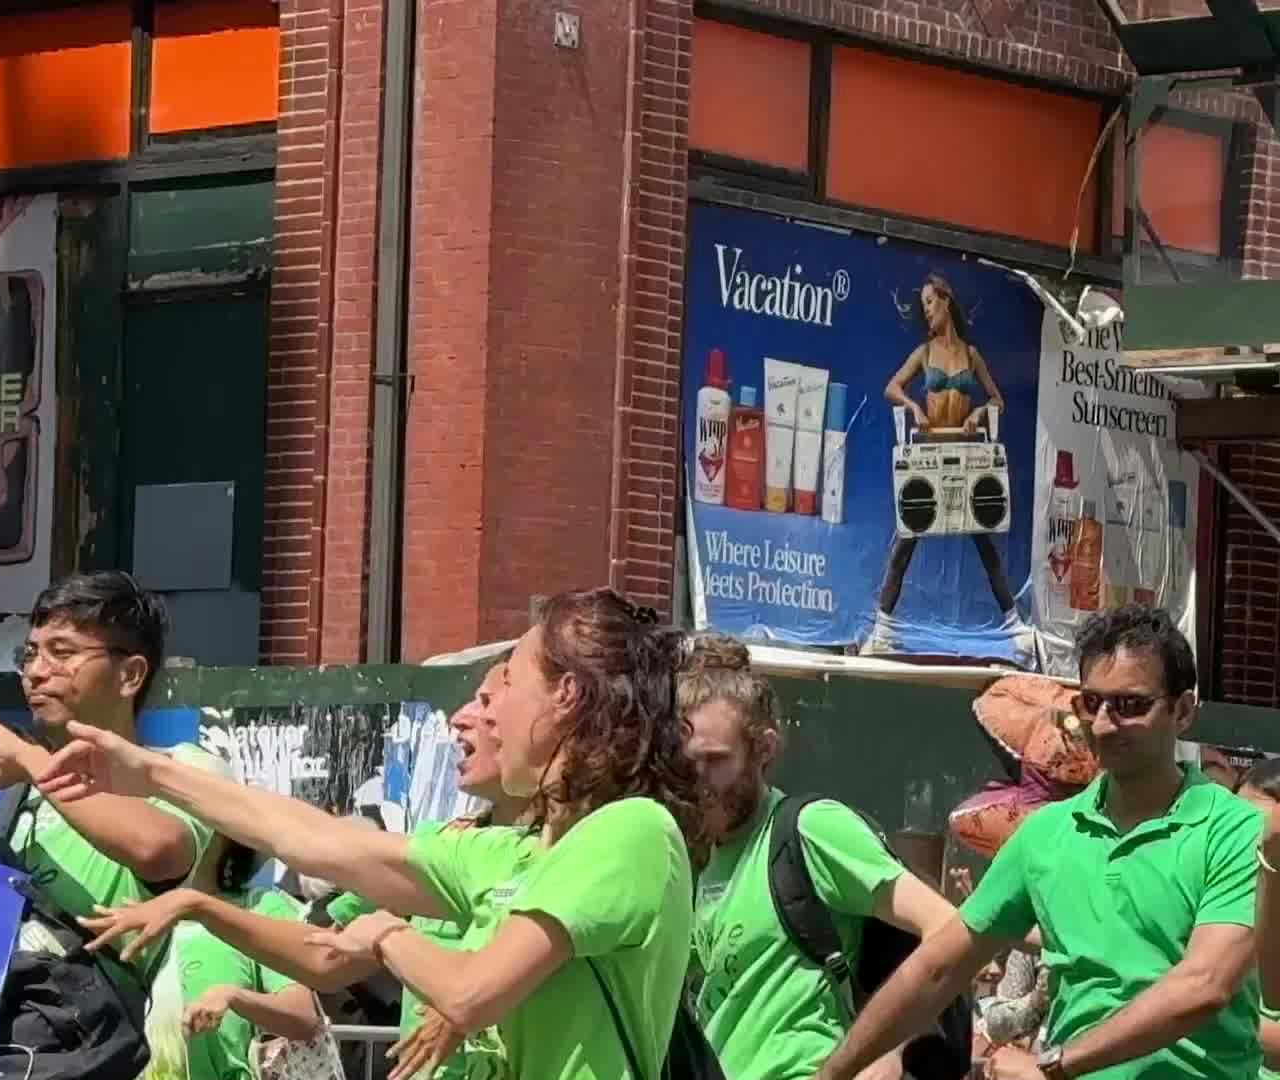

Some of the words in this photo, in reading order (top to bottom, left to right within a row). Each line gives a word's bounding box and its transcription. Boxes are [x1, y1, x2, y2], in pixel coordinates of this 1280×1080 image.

[1072, 390, 1168, 438] Sunscreen
[705, 530, 761, 569] Where
[763, 539, 826, 577] Leisure
[746, 571, 834, 613] Protection
